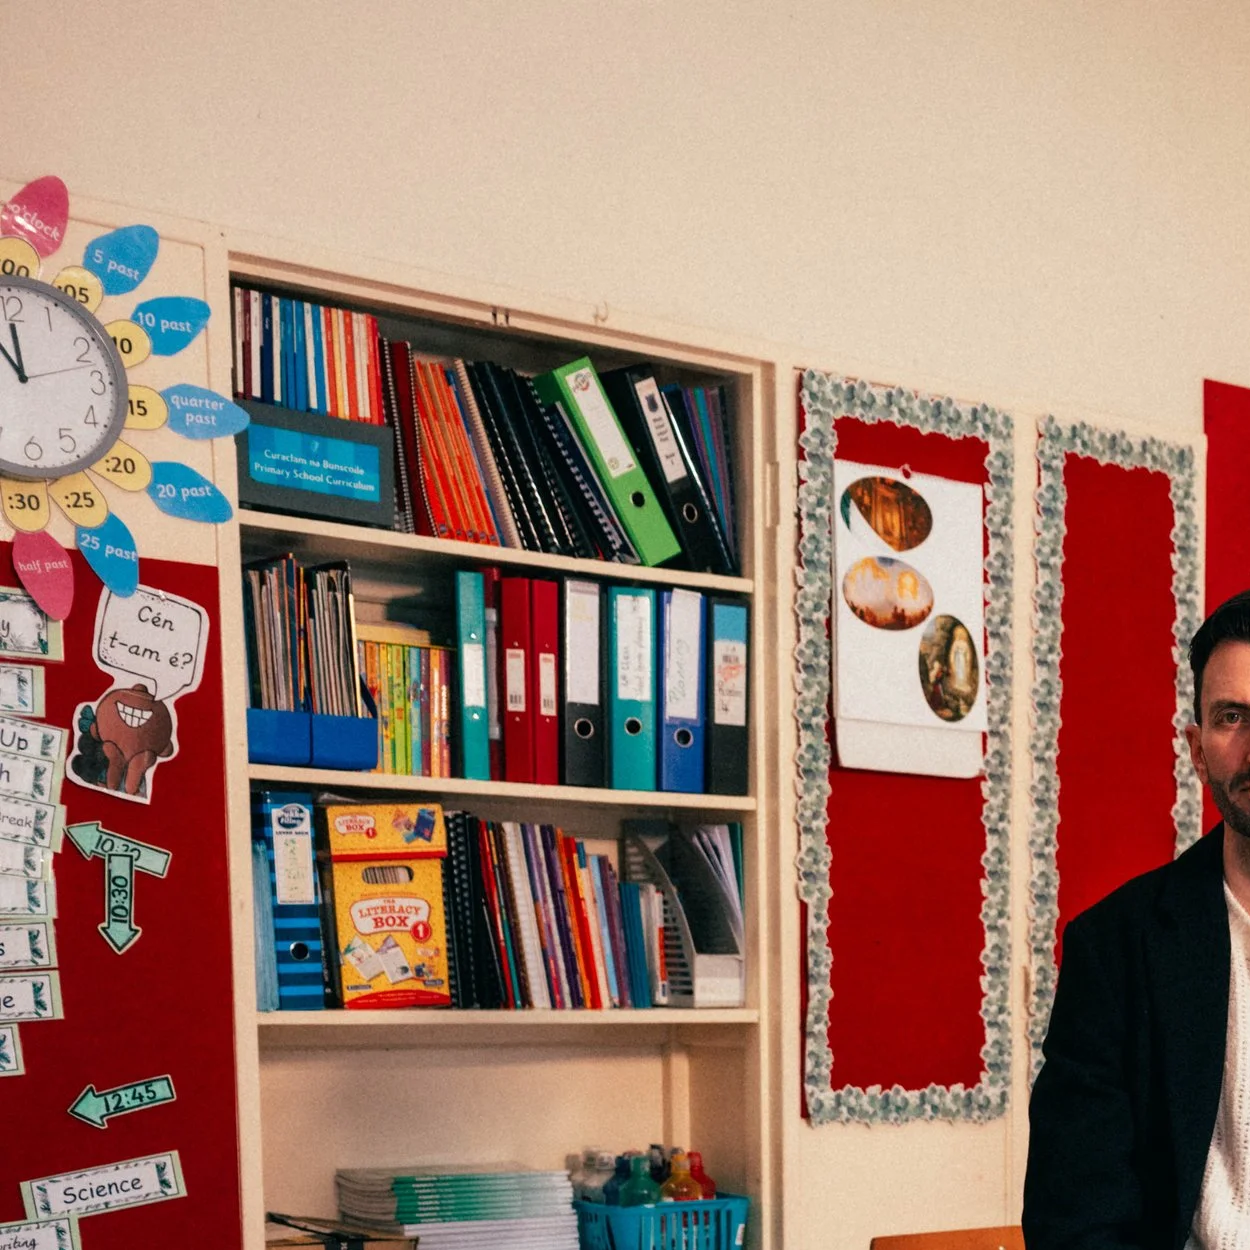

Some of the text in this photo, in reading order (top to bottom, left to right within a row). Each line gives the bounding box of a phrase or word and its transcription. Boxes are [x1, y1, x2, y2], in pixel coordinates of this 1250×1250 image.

[93, 249, 139, 281] 5 past
[44, 306, 52, 333] 1
[138, 311, 193, 333] 10 past
[72, 337, 92, 363] 2
[90, 369, 107, 396] 3
[170, 393, 225, 412] quarter
[83, 405, 100, 428] 4
[185, 409, 217, 427] past
[23, 435, 44, 462] 6
[58, 428, 77, 453] 5
[104, 458, 136, 475] :20
[309, 458, 321, 469] na
[253, 462, 376, 494] Primary School Curriculum
[8, 494, 41, 511] :30
[65, 492, 96, 509] :25
[157, 484, 213, 500] 20 past
[79, 533, 138, 563] 25 past
[17, 558, 69, 575] half past
[137, 605, 175, 632] Cén
[108, 631, 193, 670] t-am é?
[111, 875, 129, 924] 10:30
[358, 905, 421, 918] LITERACY
[372, 915, 410, 929] BOX
[416, 923, 424, 938] 1
[103, 1083, 157, 1112] 12:45
[62, 1177, 144, 1205] Science
